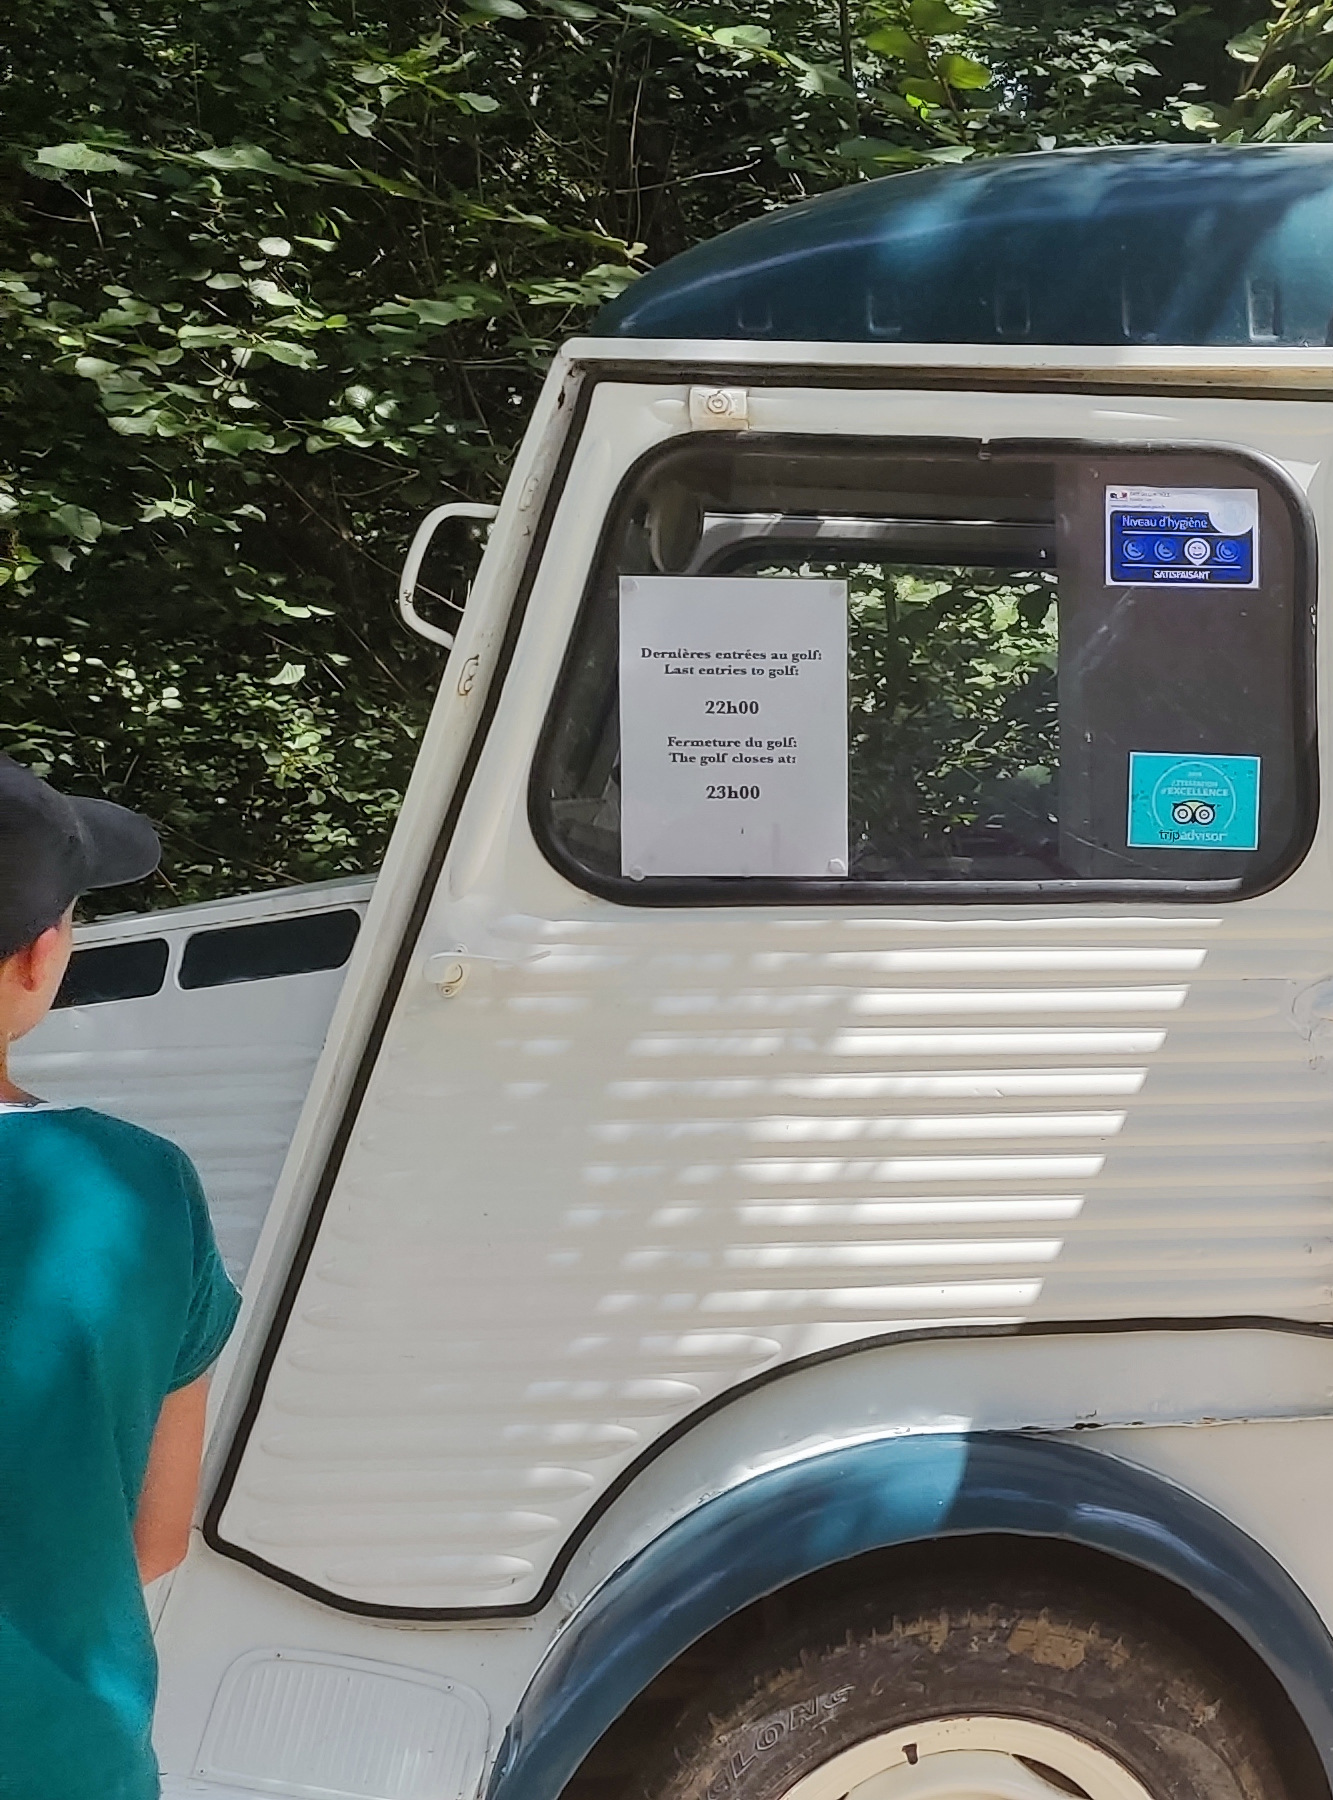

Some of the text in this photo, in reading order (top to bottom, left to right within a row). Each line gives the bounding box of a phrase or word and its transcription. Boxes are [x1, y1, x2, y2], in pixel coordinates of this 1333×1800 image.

[1122, 515, 1208, 530] Niveau d'hygiène
[1154, 570, 1210, 580] SATISFAISANT
[642, 648, 711, 659] Dernières
[716, 650, 766, 659] entrées
[792, 650, 821, 663] golf:
[665, 664, 694, 674] Last
[699, 665, 747, 675] entries
[769, 666, 798, 678] golf:
[705, 701, 759, 714] 22h00
[668, 737, 797, 750] Fermeture du golf:
[669, 753, 796, 766] The golf closes at:
[706, 786, 759, 799] 23h00
[1158, 829, 1228, 842] tripadvisor
